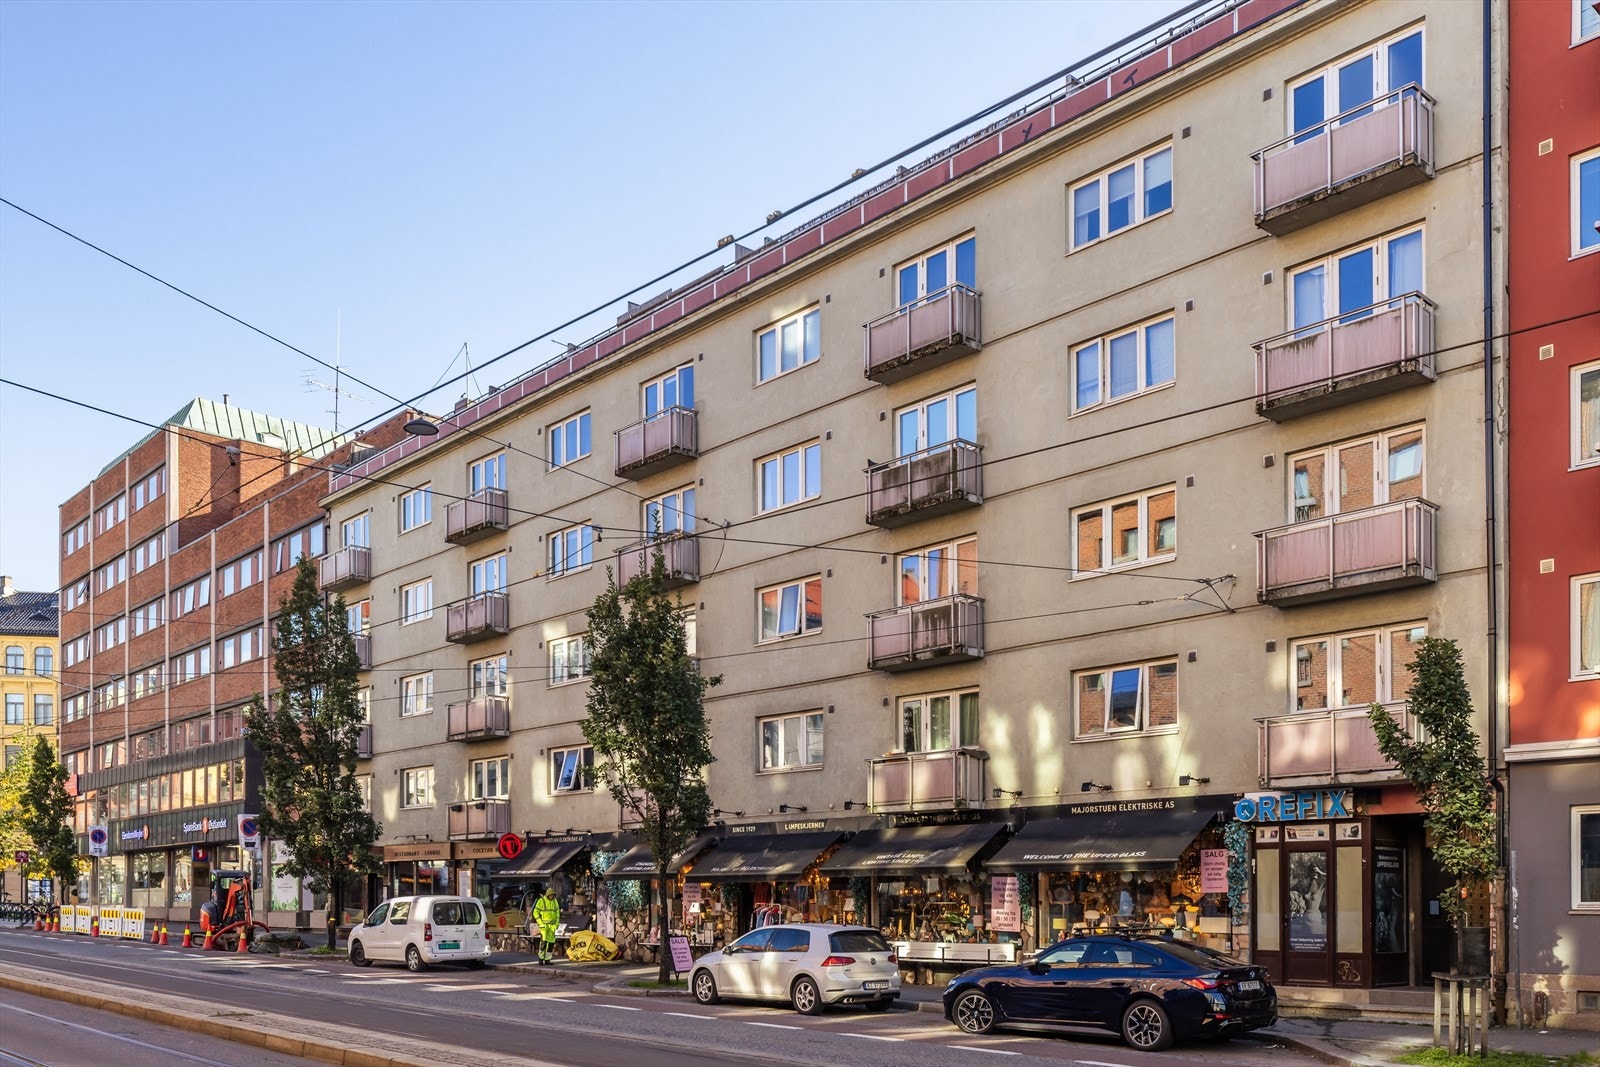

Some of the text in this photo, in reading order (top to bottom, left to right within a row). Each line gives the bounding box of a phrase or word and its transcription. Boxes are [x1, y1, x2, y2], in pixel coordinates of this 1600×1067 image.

[1071, 801, 1175, 814] MAJORSTUEN ELEKTRISKE AS
[1258, 790, 1348, 822] REFIX
[732, 825, 746, 833] SINCE
[784, 821, 825, 831] LAMPESKJERMER
[1204, 850, 1224, 858] SALG
